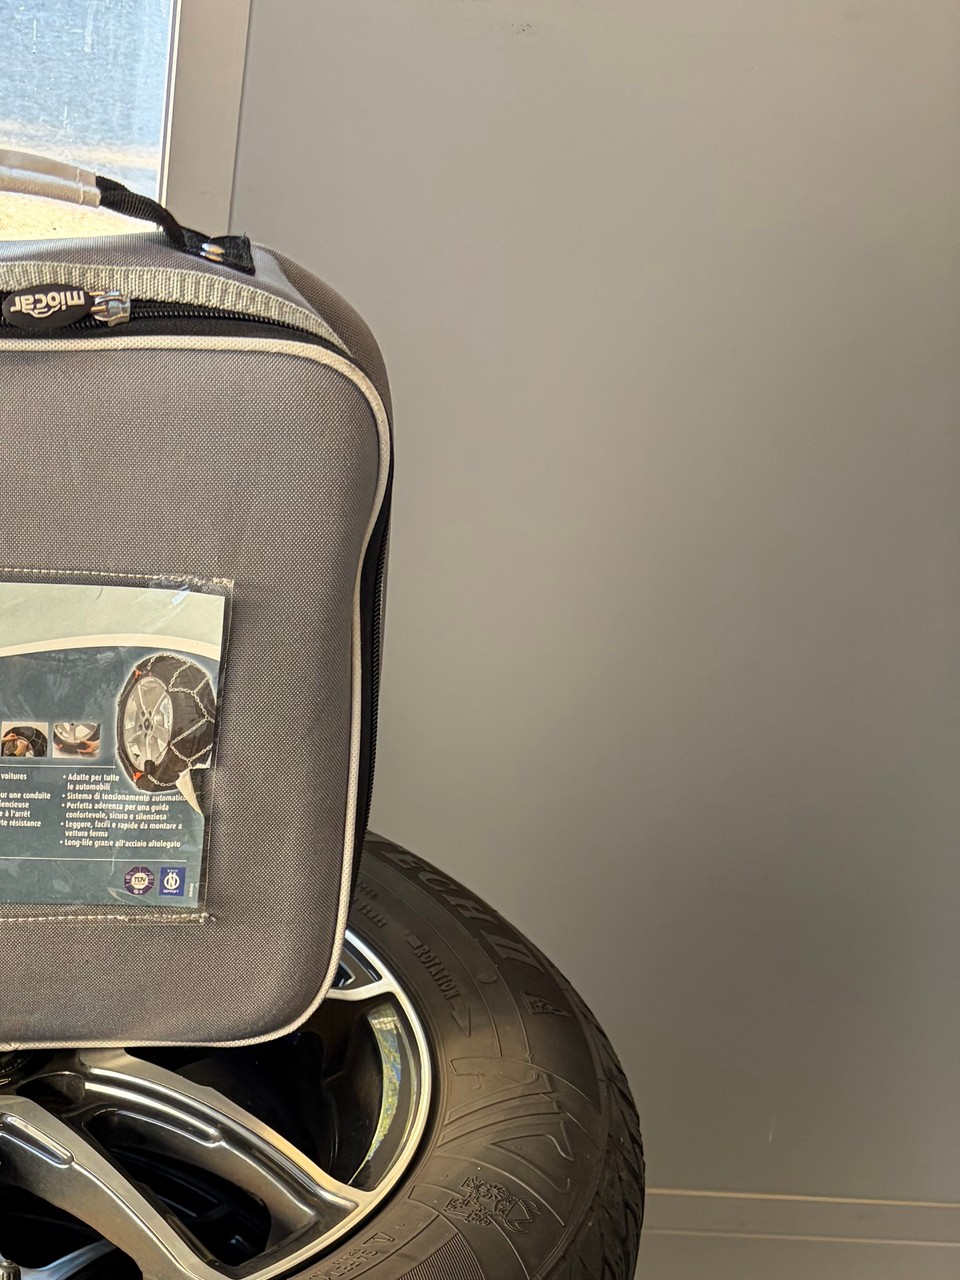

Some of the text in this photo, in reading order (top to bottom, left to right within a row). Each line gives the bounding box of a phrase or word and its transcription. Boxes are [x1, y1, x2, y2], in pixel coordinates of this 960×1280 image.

[10, 290, 85, 315] miocar
[1, 772, 27, 780] voitures
[67, 773, 120, 783] Adatte per tutte
[75, 783, 111, 791] automobili
[23, 792, 51, 800] conduite
[67, 792, 92, 800] Sistema
[94, 792, 100, 800] di
[102, 793, 150, 802] tensionamento
[94, 802, 123, 810] aderenza
[151, 803, 169, 812] guida
[66, 811, 108, 820] confortevole,
[109, 812, 128, 820] sicura
[135, 812, 167, 820] silenziosa
[66, 821, 93, 829] Leggere,
[95, 820, 110, 828] facili
[118, 821, 138, 830] rapide
[64, 839, 181, 849] Long-life grazie all'acciaio altolegato
[415, 943, 462, 1000] ROTATION
